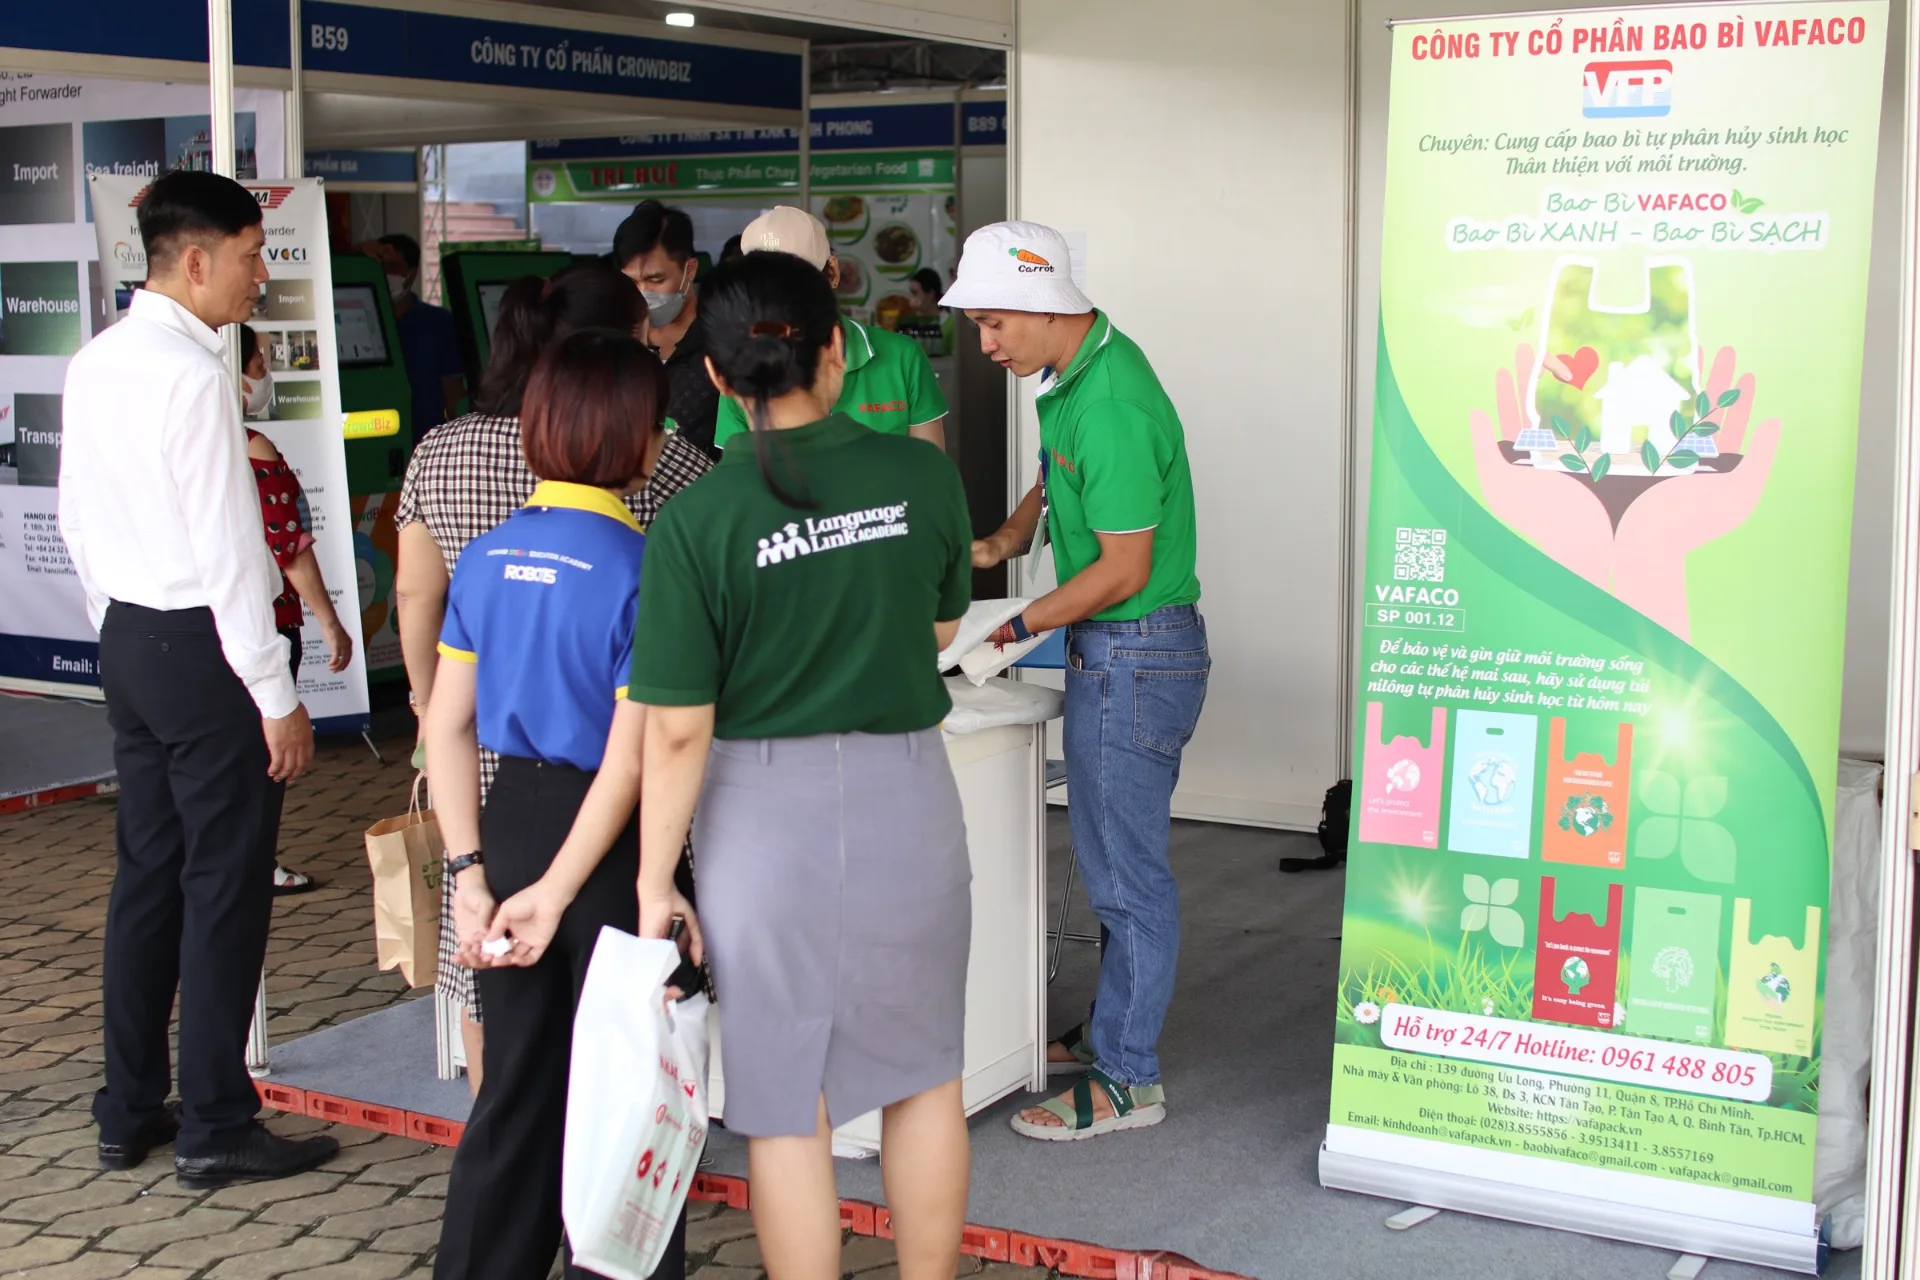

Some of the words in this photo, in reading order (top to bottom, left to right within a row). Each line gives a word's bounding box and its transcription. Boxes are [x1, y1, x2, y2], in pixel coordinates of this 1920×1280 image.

[311, 24, 349, 51] B59
[1412, 29, 1480, 60] CÔNG
[1490, 31, 1520, 57] TY
[1528, 17, 1563, 55] CỔ
[1572, 17, 1643, 53] PHẦN
[1654, 23, 1707, 50] BAO
[1717, 15, 1744, 48] BÌ
[1754, 16, 1866, 47] VAFACO
[471, 36, 516, 66] CÔNG
[520, 45, 541, 68] TY
[545, 40, 569, 70] CỔ
[616, 55, 691, 82] CROWDBIZ
[20, 84, 83, 101] Forwarder
[1584, 68, 1672, 108] VFP
[827, 120, 873, 136] PHONG
[1418, 134, 1489, 155] Chuyên:
[1495, 132, 1540, 153] Cung
[1544, 129, 1577, 152] cấp
[1582, 131, 1617, 148] bao
[1623, 130, 1642, 147] bì
[1646, 131, 1667, 150] tự
[1669, 129, 1719, 149] phân
[1725, 126, 1761, 149] hủy
[1766, 127, 1808, 144] sinh
[1813, 127, 1849, 147] học
[13, 162, 59, 184] Import
[875, 161, 908, 175] Food
[1506, 157, 1546, 175] Thân
[1552, 155, 1599, 177] thiện
[1605, 155, 1632, 173] với
[1637, 154, 1673, 172] môi
[1678, 153, 1748, 175] trường.
[1546, 193, 1597, 213] Bao
[1603, 192, 1636, 212] Bì
[1638, 193, 1727, 211] VAFACO
[1452, 223, 1500, 243] Bao
[1506, 222, 1536, 242] Bì
[1540, 220, 1618, 242] XANH
[1653, 221, 1704, 242] Bao
[1711, 222, 1744, 241] Bì
[1749, 219, 1822, 246] SẠCH
[1018, 264, 1055, 273] Carrot
[6, 297, 79, 314] Warehouse
[278, 294, 305, 304] Import
[277, 395, 320, 404] Warehouse
[19, 427, 62, 448] Transp
[24, 512, 46, 520] HANOI
[805, 502, 907, 535] Language
[809, 529, 860, 553] Link
[858, 522, 908, 542] ACADEMIC
[1375, 584, 1459, 606] VAFACO
[1377, 609, 1400, 622] SP
[1405, 611, 1454, 627] 001.12
[53, 655, 93, 674] Email:
[1379, 637, 1403, 654] Để
[1402, 641, 1429, 656] bảo
[1432, 644, 1448, 660] vệ
[1451, 645, 1467, 659] và
[1468, 647, 1493, 663] gìn
[1524, 651, 1553, 665] môi
[1556, 653, 1606, 672] trường
[1608, 655, 1644, 675] sống
[1370, 660, 1396, 674] cho
[1400, 661, 1424, 676] các
[1427, 662, 1453, 678] thế
[1451, 665, 1469, 682] hệ
[1471, 668, 1499, 682] mai
[1502, 672, 1531, 686] sau,
[1536, 672, 1564, 689] hãy
[1567, 673, 1586, 688] sử
[1587, 676, 1626, 694] dụng
[1367, 678, 1414, 697] nilông
[1418, 683, 1433, 698] tự
[1435, 684, 1470, 699] phân
[1473, 686, 1500, 704] hủy
[1502, 689, 1534, 704] sinh
[1537, 692, 1564, 709] học
[1567, 694, 1586, 708] từ
[1586, 696, 1619, 711] hôm
[1623, 701, 1652, 717] nay
[1569, 998, 1586, 1008] being
[1587, 1002, 1606, 1010] green
[1394, 1016, 1424, 1038] Hỗ
[1426, 1024, 1457, 1047] trợ
[1461, 1026, 1512, 1051] 24/7
[1514, 1033, 1596, 1065] Hotline:
[1601, 1046, 1656, 1072] 0961
[1662, 1055, 1706, 1080] 488
[1712, 1062, 1756, 1086] 805
[1343, 1064, 1364, 1076] Nhà
[1368, 1069, 1389, 1082] máy
[1392, 1072, 1400, 1082] &
[1426, 1078, 1463, 1093] phòng:
[1503, 1088, 1516, 1100] Đs
[1519, 1091, 1529, 1104] 3,
[1532, 1093, 1556, 1106] KCN
[1560, 1097, 1579, 1110] Tân
[1583, 1100, 1605, 1115] Tạo,
[1608, 1105, 1617, 1116] P.
[1620, 1106, 1641, 1119] Tân
[1645, 1110, 1664, 1124] Tạo
[1668, 1114, 1679, 1127] A,
[1683, 1116, 1694, 1128] Q.
[1390, 1055, 1407, 1069] Địa
[1437, 1063, 1457, 1075] 139
[1516, 1075, 1545, 1090] Long,
[1596, 1086, 1611, 1099] 11,
[1616, 1089, 1646, 1106] Quận
[1721, 1105, 1754, 1120] Minh.
[1488, 1102, 1534, 1120] Website:
[1537, 1109, 1643, 1137] https://vafapack.vn
[1419, 1107, 1443, 1122] Điện
[1447, 1112, 1477, 1127] thoại:
[1480, 1117, 1568, 1140] (028)3.8555856
[1579, 1132, 1639, 1152] 3.9513411
[1651, 1143, 1714, 1163] 3.8557169
[1348, 1111, 1380, 1127] Email:
[1383, 1116, 1512, 1148] kinhdoanh@vafapack.vn
[1523, 1140, 1657, 1171] baobivafaco@gmail.com
[1669, 1166, 1792, 1194] vafapack@gmail.com
